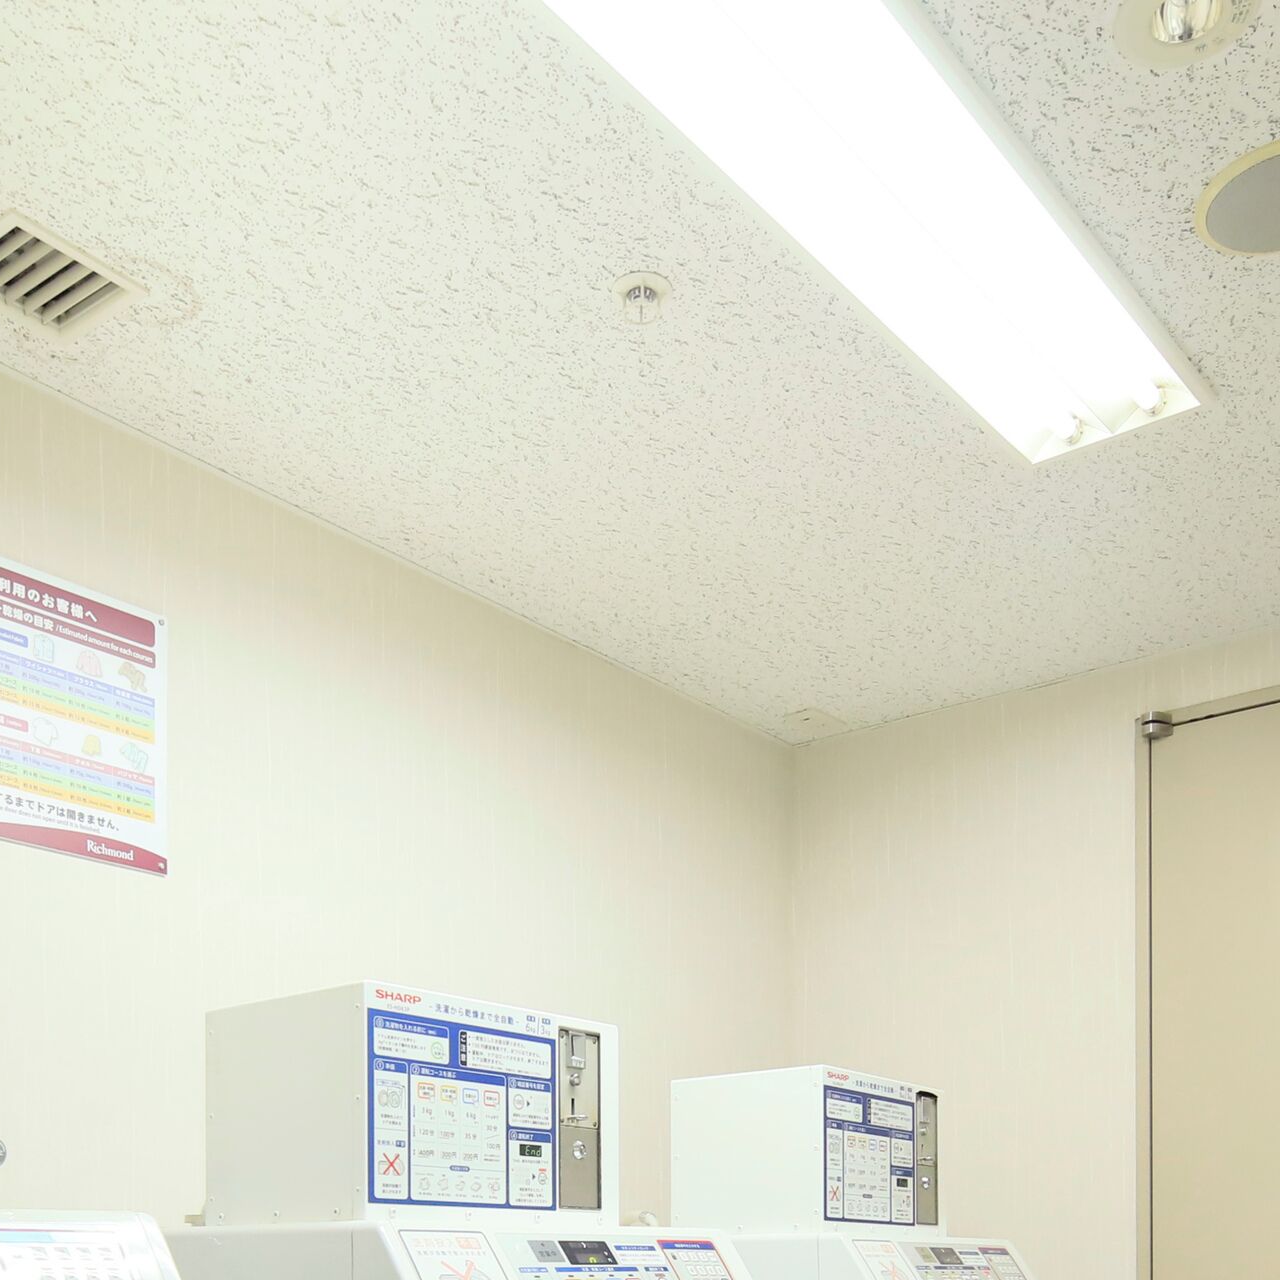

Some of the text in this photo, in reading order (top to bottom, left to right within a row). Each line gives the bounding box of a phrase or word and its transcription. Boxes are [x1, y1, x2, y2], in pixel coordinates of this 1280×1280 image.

[59, 624, 88, 643] Estimated
[87, 633, 110, 650] amount
[86, 839, 135, 862] Richmond
[376, 988, 422, 1004] SHARP
[827, 1071, 849, 1082] SHARP
[525, 1145, 542, 1157] End
